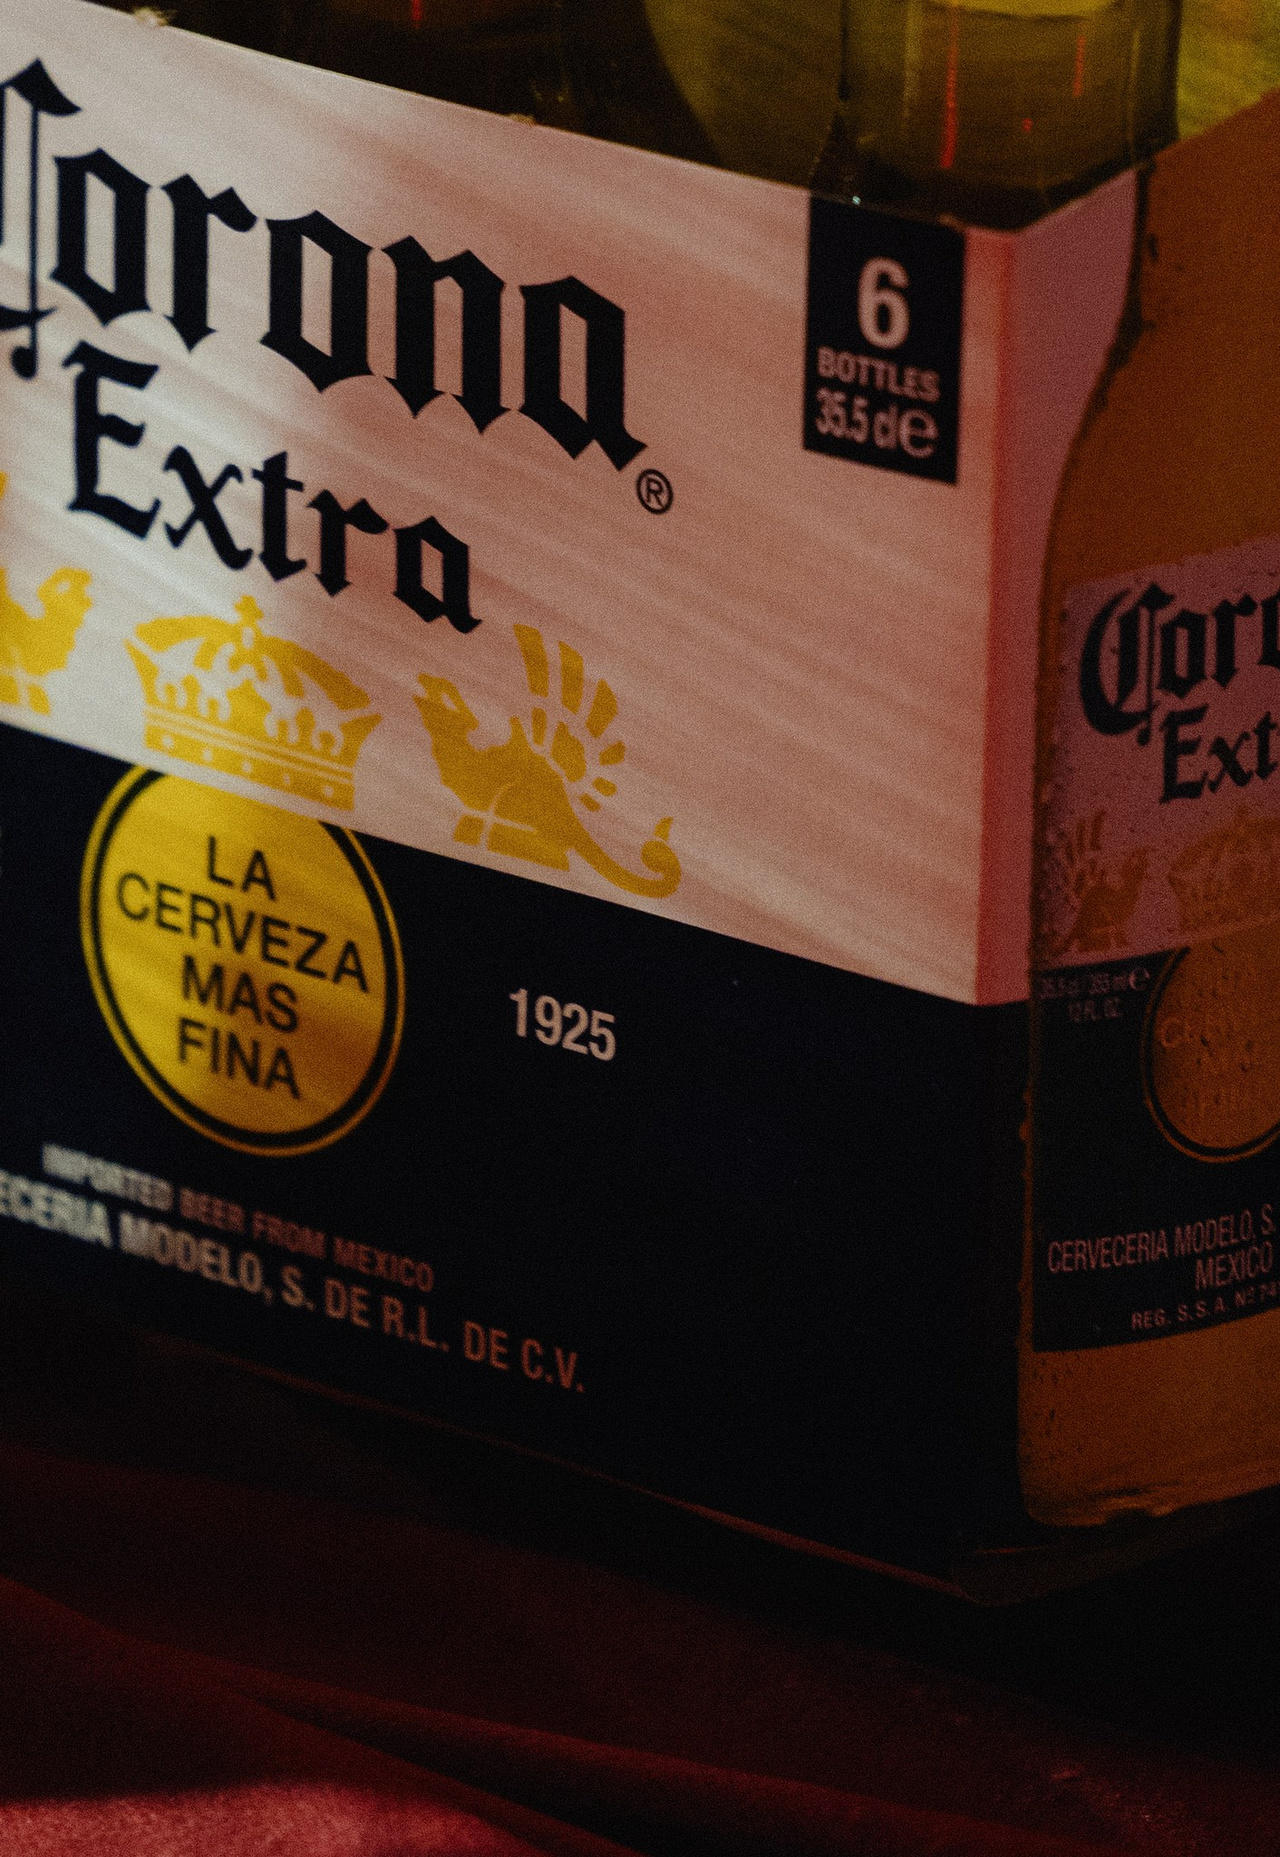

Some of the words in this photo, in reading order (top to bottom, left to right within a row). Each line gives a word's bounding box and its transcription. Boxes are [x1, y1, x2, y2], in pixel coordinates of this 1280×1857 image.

[857, 255, 912, 351] 6
[817, 344, 941, 404] BOTTLES
[62, 341, 483, 634] Extra
[207, 836, 279, 901] LA
[116, 872, 371, 993] CERVEZA
[181, 954, 300, 1033] MAS
[508, 988, 618, 1062] 1925
[177, 1017, 302, 1101] FINA
[178, 1186, 246, 1234] BEER
[251, 1208, 328, 1261] FROM
[332, 1234, 436, 1294] MEXICO
[1047, 1228, 1171, 1275] CERVECERIA
[1194, 1239, 1275, 1292] MEXICO
[118, 1208, 276, 1307] MODELO,
[279, 1262, 317, 1312] S.
[323, 1277, 373, 1330] DE
[380, 1294, 451, 1353] R.L.
[461, 1319, 511, 1373] DE
[519, 1338, 588, 1394] C.V.
